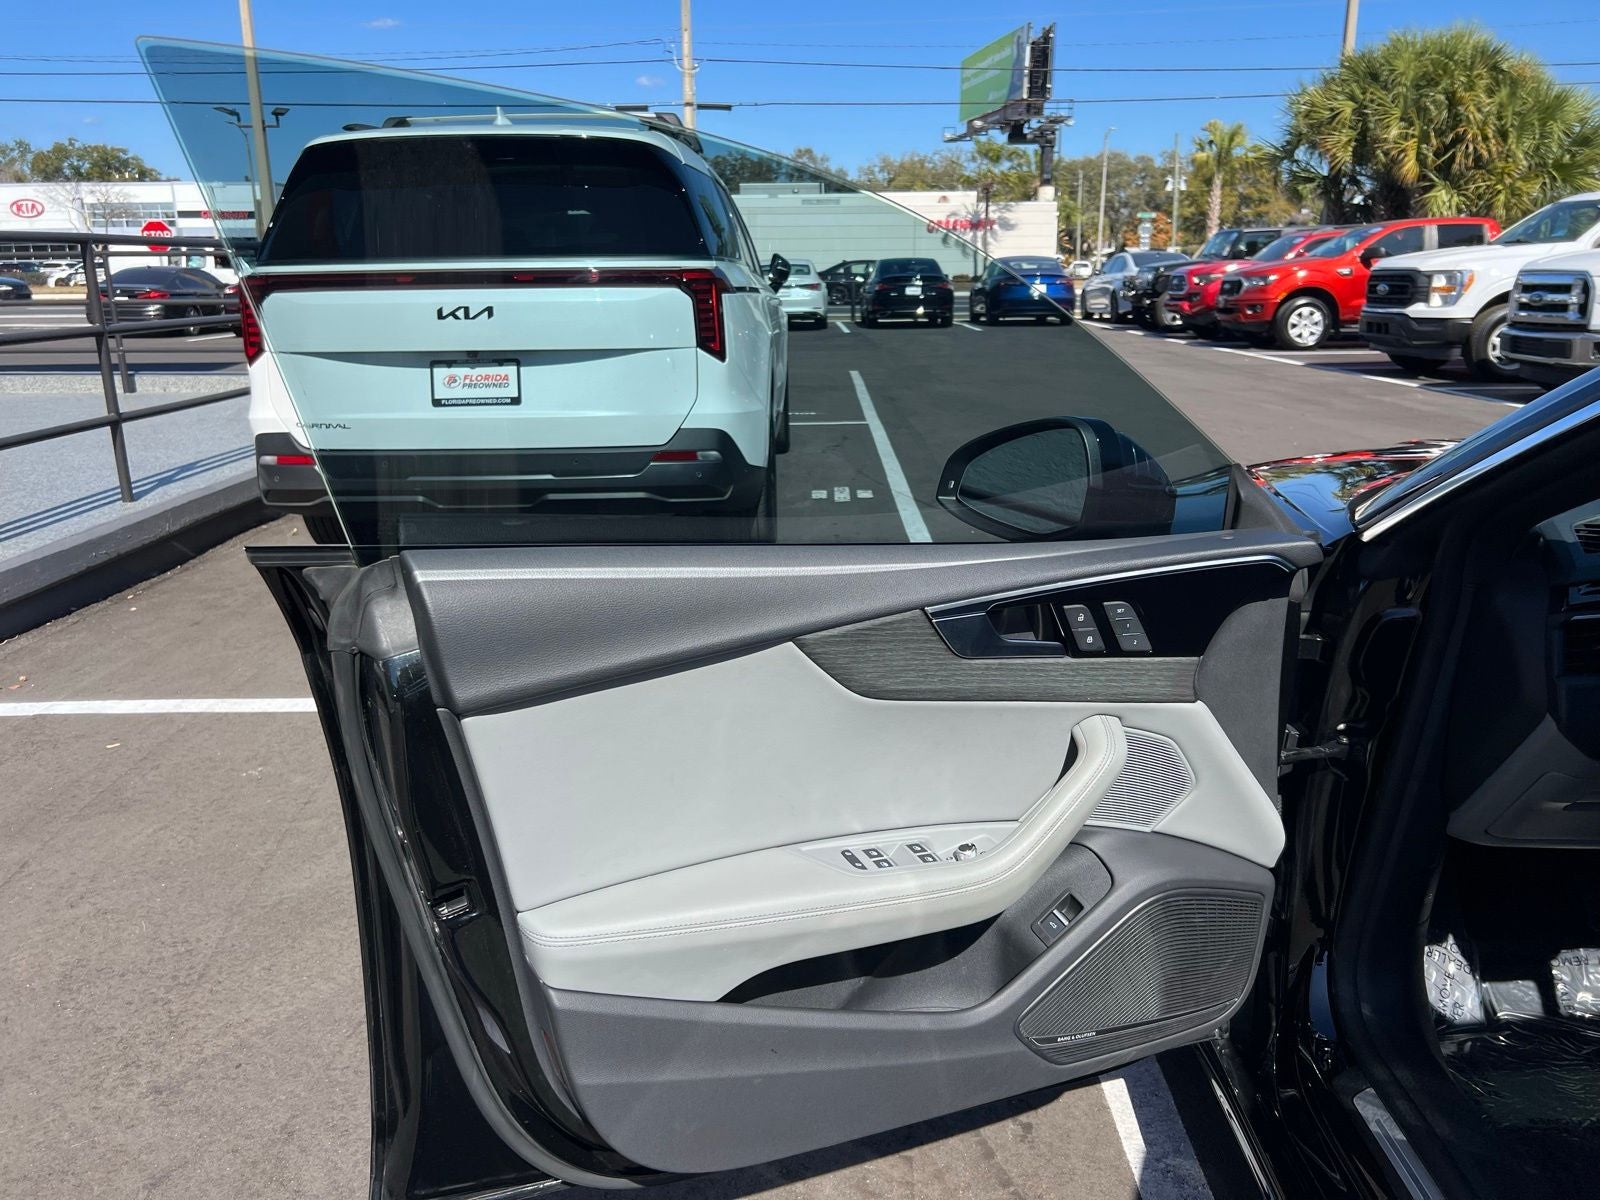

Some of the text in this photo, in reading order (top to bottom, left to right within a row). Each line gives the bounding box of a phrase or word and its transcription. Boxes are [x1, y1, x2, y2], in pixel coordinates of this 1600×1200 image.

[14, 202, 42, 216] KIA
[436, 305, 494, 320] KIA
[463, 374, 510, 383] FLORIDA
[462, 382, 510, 390] PREOWNED
[1426, 946, 1472, 975] DEALER
[1075, 1031, 1096, 1039] OLUFSEN
